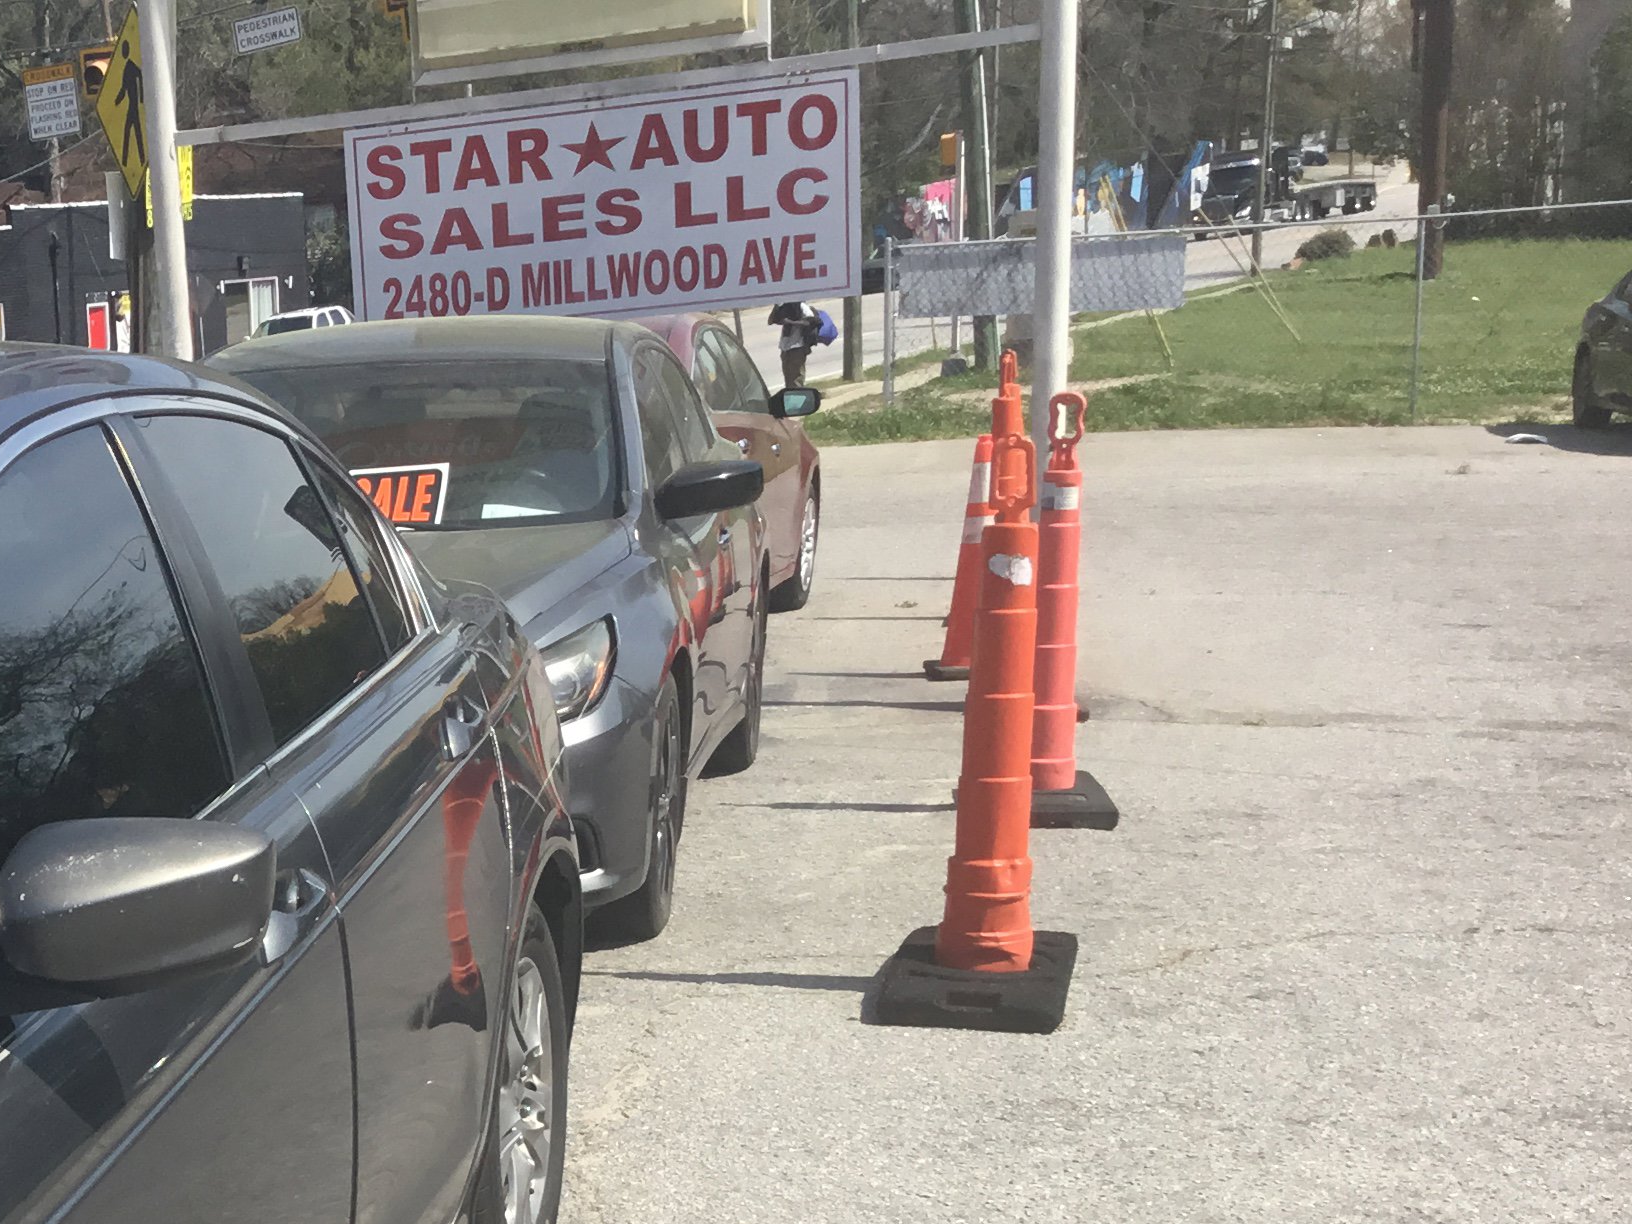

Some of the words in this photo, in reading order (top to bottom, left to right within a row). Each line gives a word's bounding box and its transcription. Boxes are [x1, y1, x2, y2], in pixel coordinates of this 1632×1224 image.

[237, 12, 295, 33] PEDESTRIAN
[240, 27, 296, 48] CROSSWALK
[27, 87, 44, 99] STOP
[55, 120, 78, 132] CLEAR
[367, 128, 552, 200] STAR
[630, 93, 838, 170] AUTO
[379, 188, 643, 260] SALES
[674, 167, 830, 228] LLC
[383, 266, 510, 320] 2480-D
[521, 242, 727, 309] MILLWOOD
[739, 233, 829, 286] AVE.
